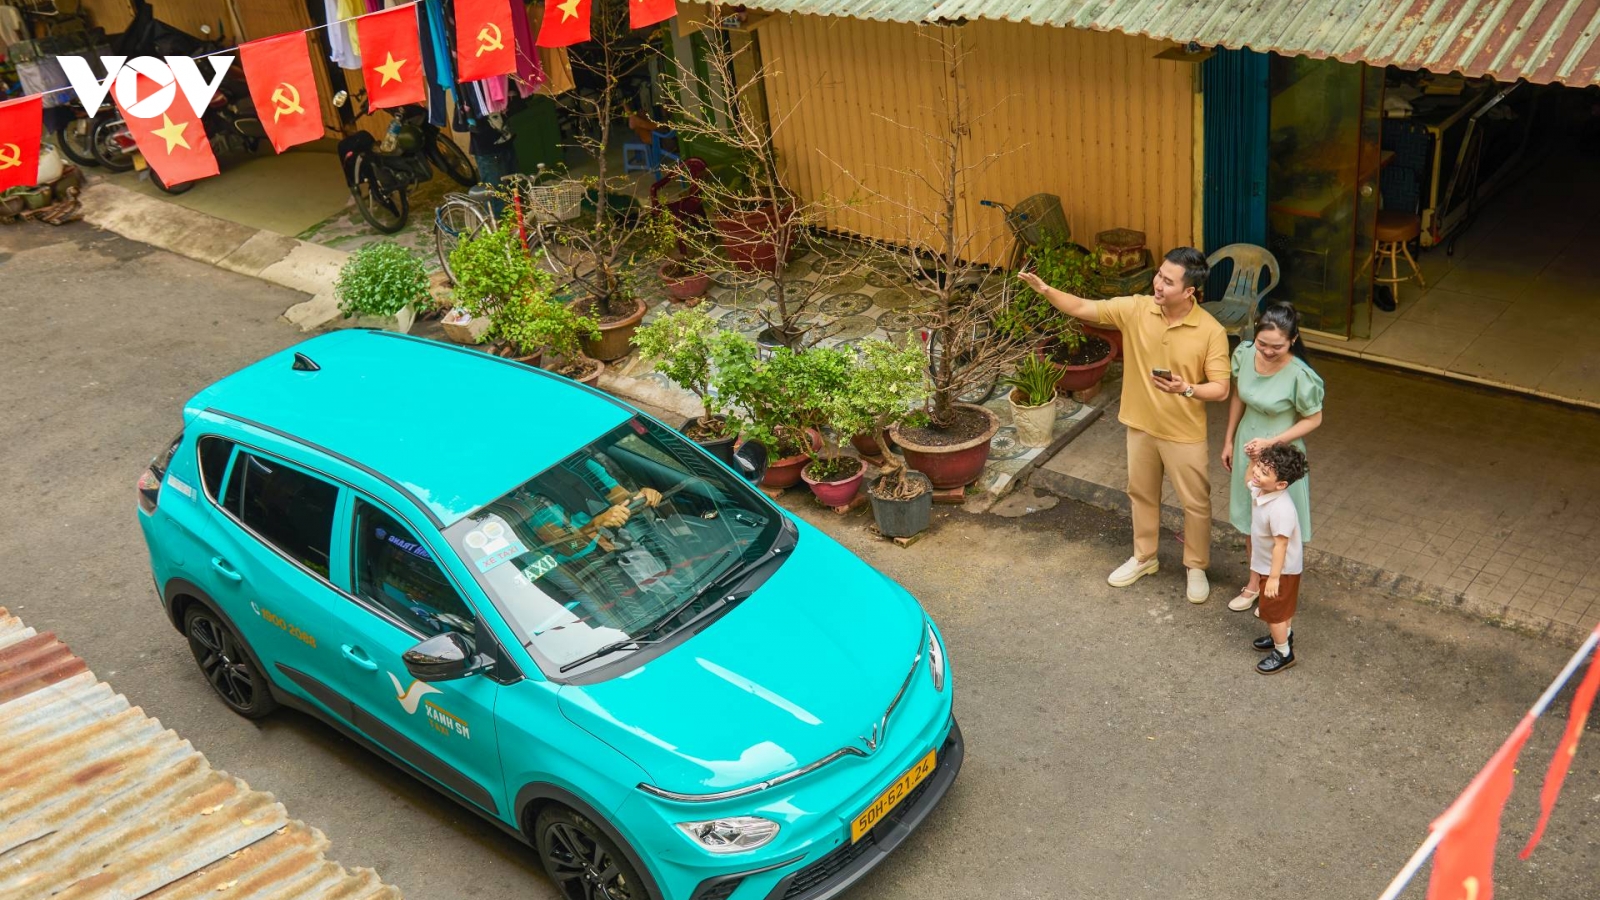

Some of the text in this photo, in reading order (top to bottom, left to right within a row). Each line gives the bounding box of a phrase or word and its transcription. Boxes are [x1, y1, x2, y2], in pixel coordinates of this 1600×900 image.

[483, 546, 519, 568] XE TAXI
[514, 556, 555, 585] TAXI
[261, 608, 287, 631] 1900
[425, 704, 470, 739] XANH SM
[859, 759, 929, 832] 50H-621.24
